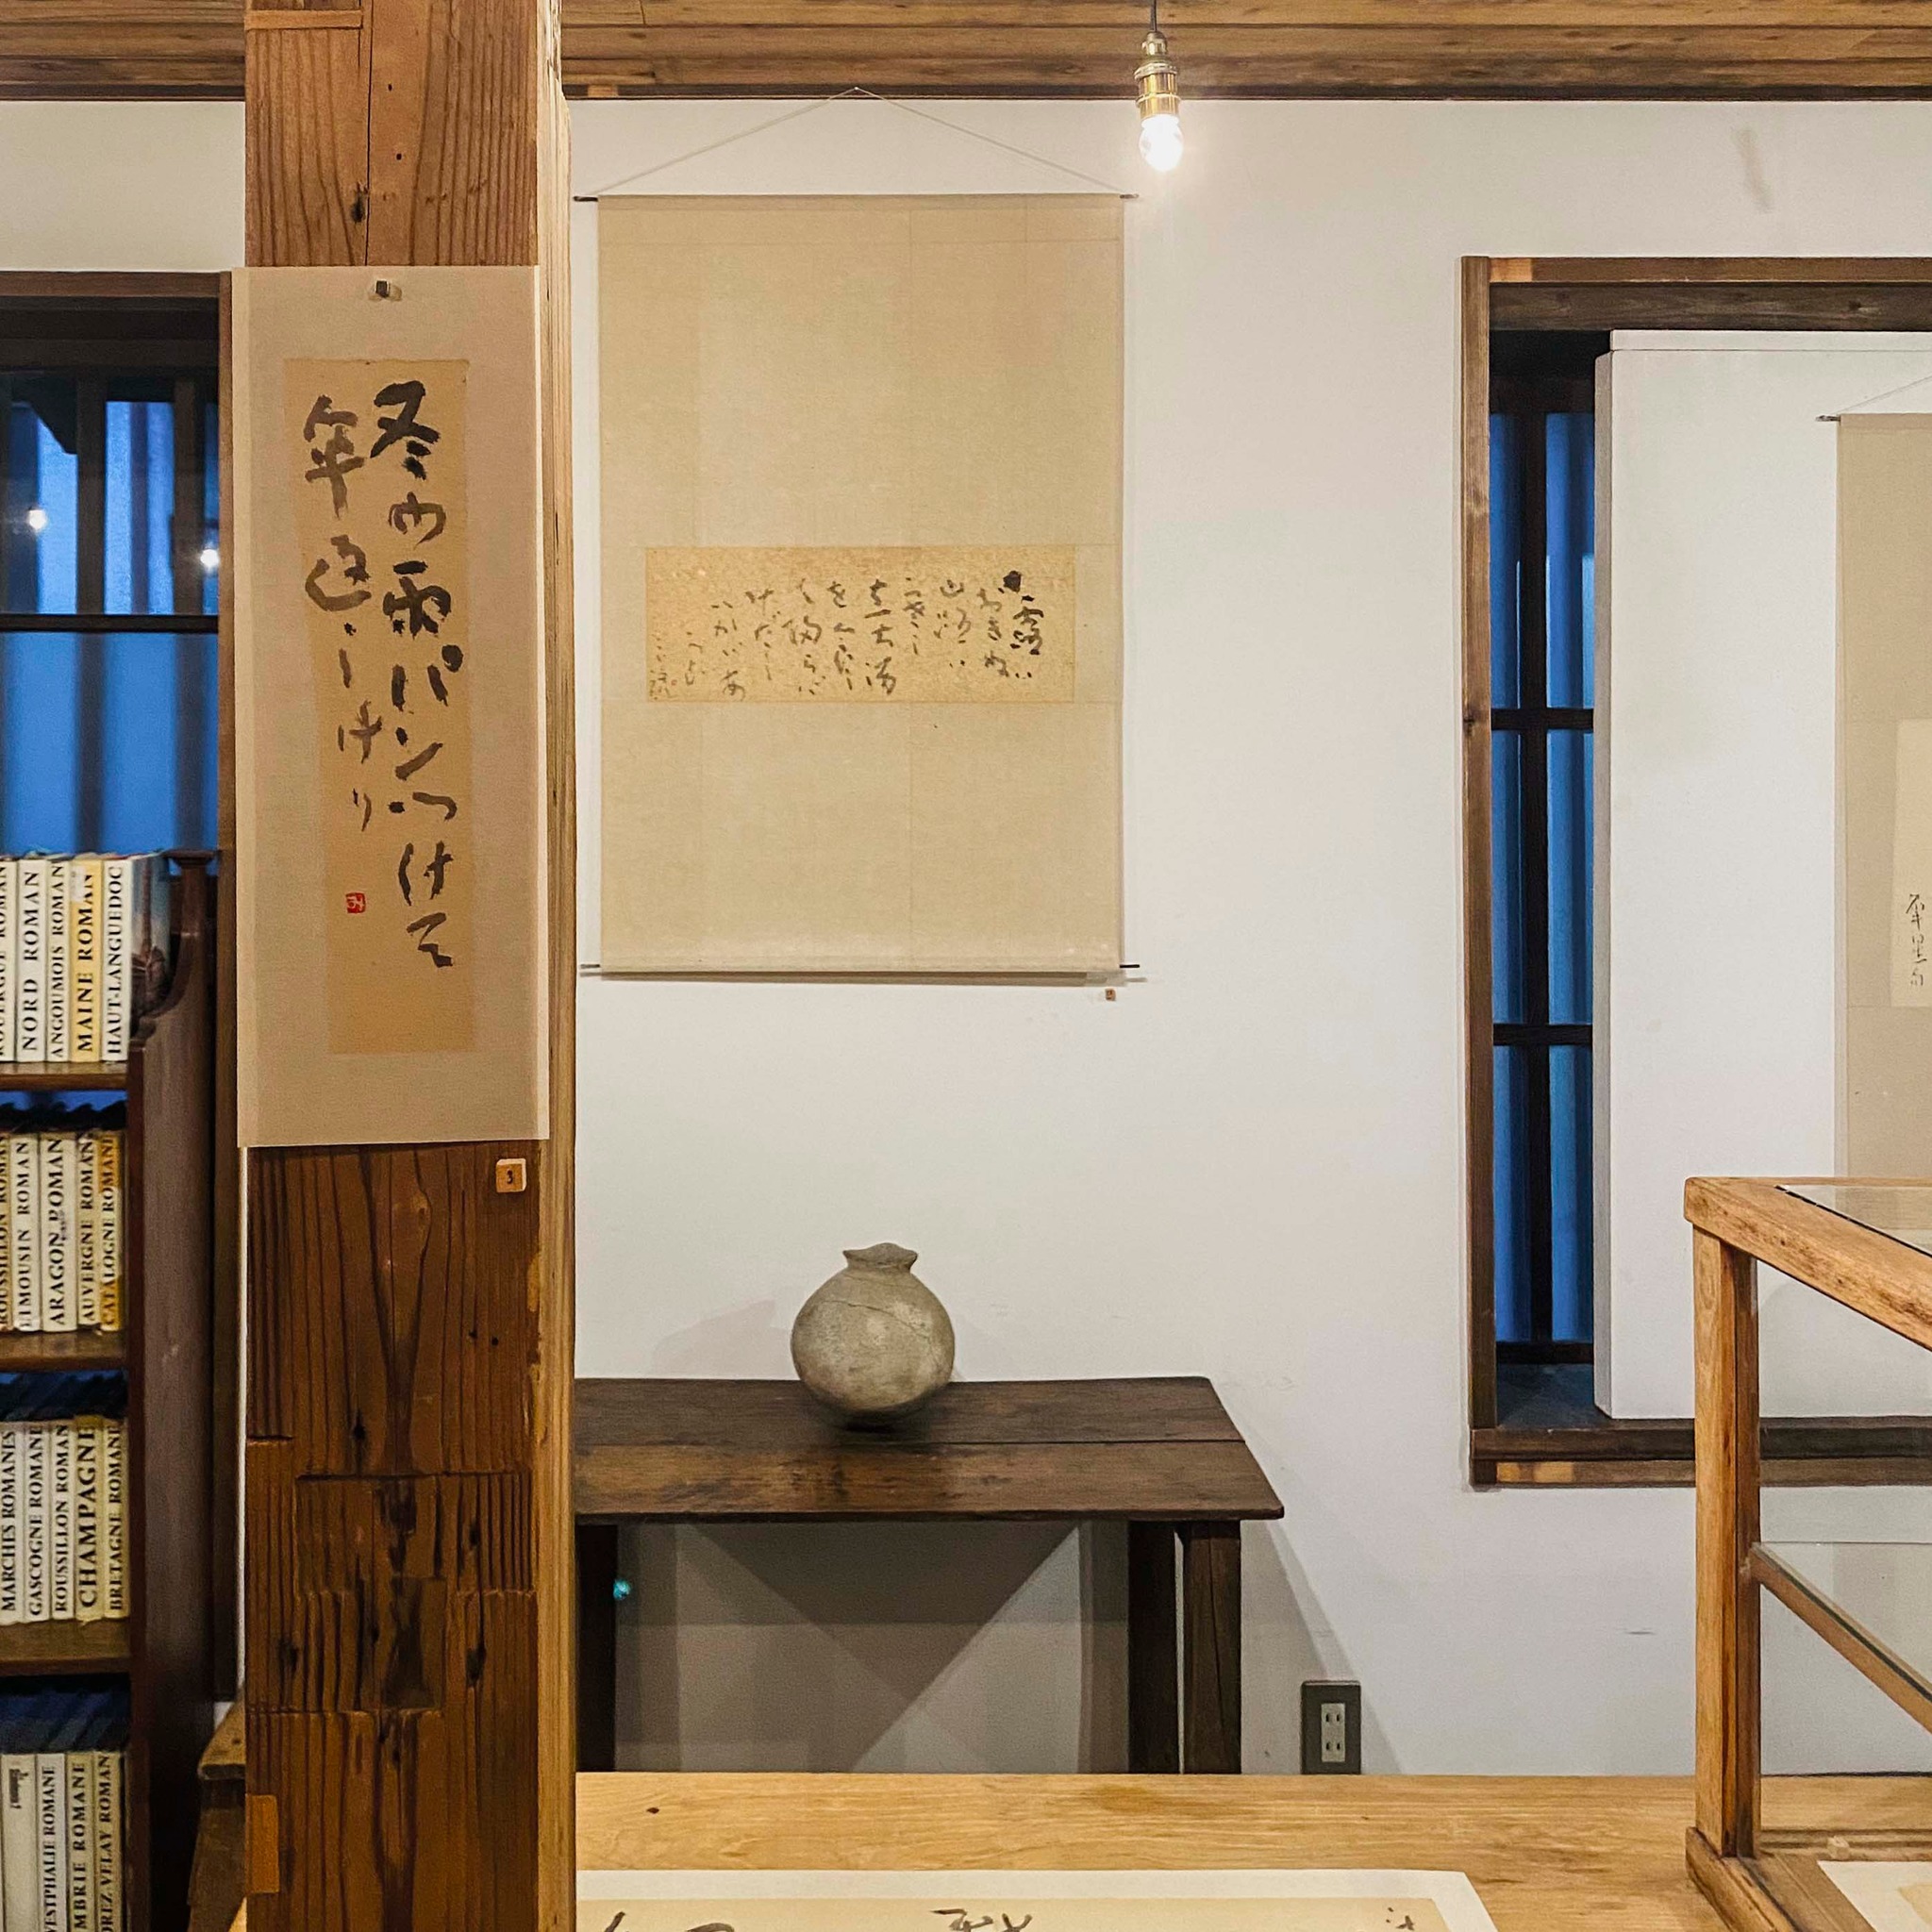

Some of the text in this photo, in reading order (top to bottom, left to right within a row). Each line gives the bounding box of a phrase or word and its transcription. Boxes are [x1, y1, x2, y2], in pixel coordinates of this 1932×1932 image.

[23, 872, 40, 1051] NORD ROMAN
[51, 865, 64, 1058] ANGOUMOIS ROMAN
[77, 973, 92, 1052] MAINE
[108, 866, 123, 1054] HAUT-LANGUEDOC
[16, 1141, 30, 1215] ROMAN
[79, 1141, 94, 1321] AUVERGNE ROMAN
[101, 1139, 117, 1325] CATALOGNE ROMANE
[48, 1232, 65, 1325] ARAGON
[1, 1429, 16, 1611] MARCHES ROMANES
[29, 1426, 43, 1616] GASCOGNE ROMANE
[55, 1424, 69, 1612] ROUSSILLON ROMAN
[77, 1424, 97, 1607] CHAMPAGNE
[108, 1427, 124, 1610] BRETAGNE ROMANE
[42, 1766, 57, 1836] ROMANE
[73, 1763, 86, 1851] ROMANE
[98, 1756, 112, 1823] ROMAN
[100, 1830, 113, 1886] VELAY
